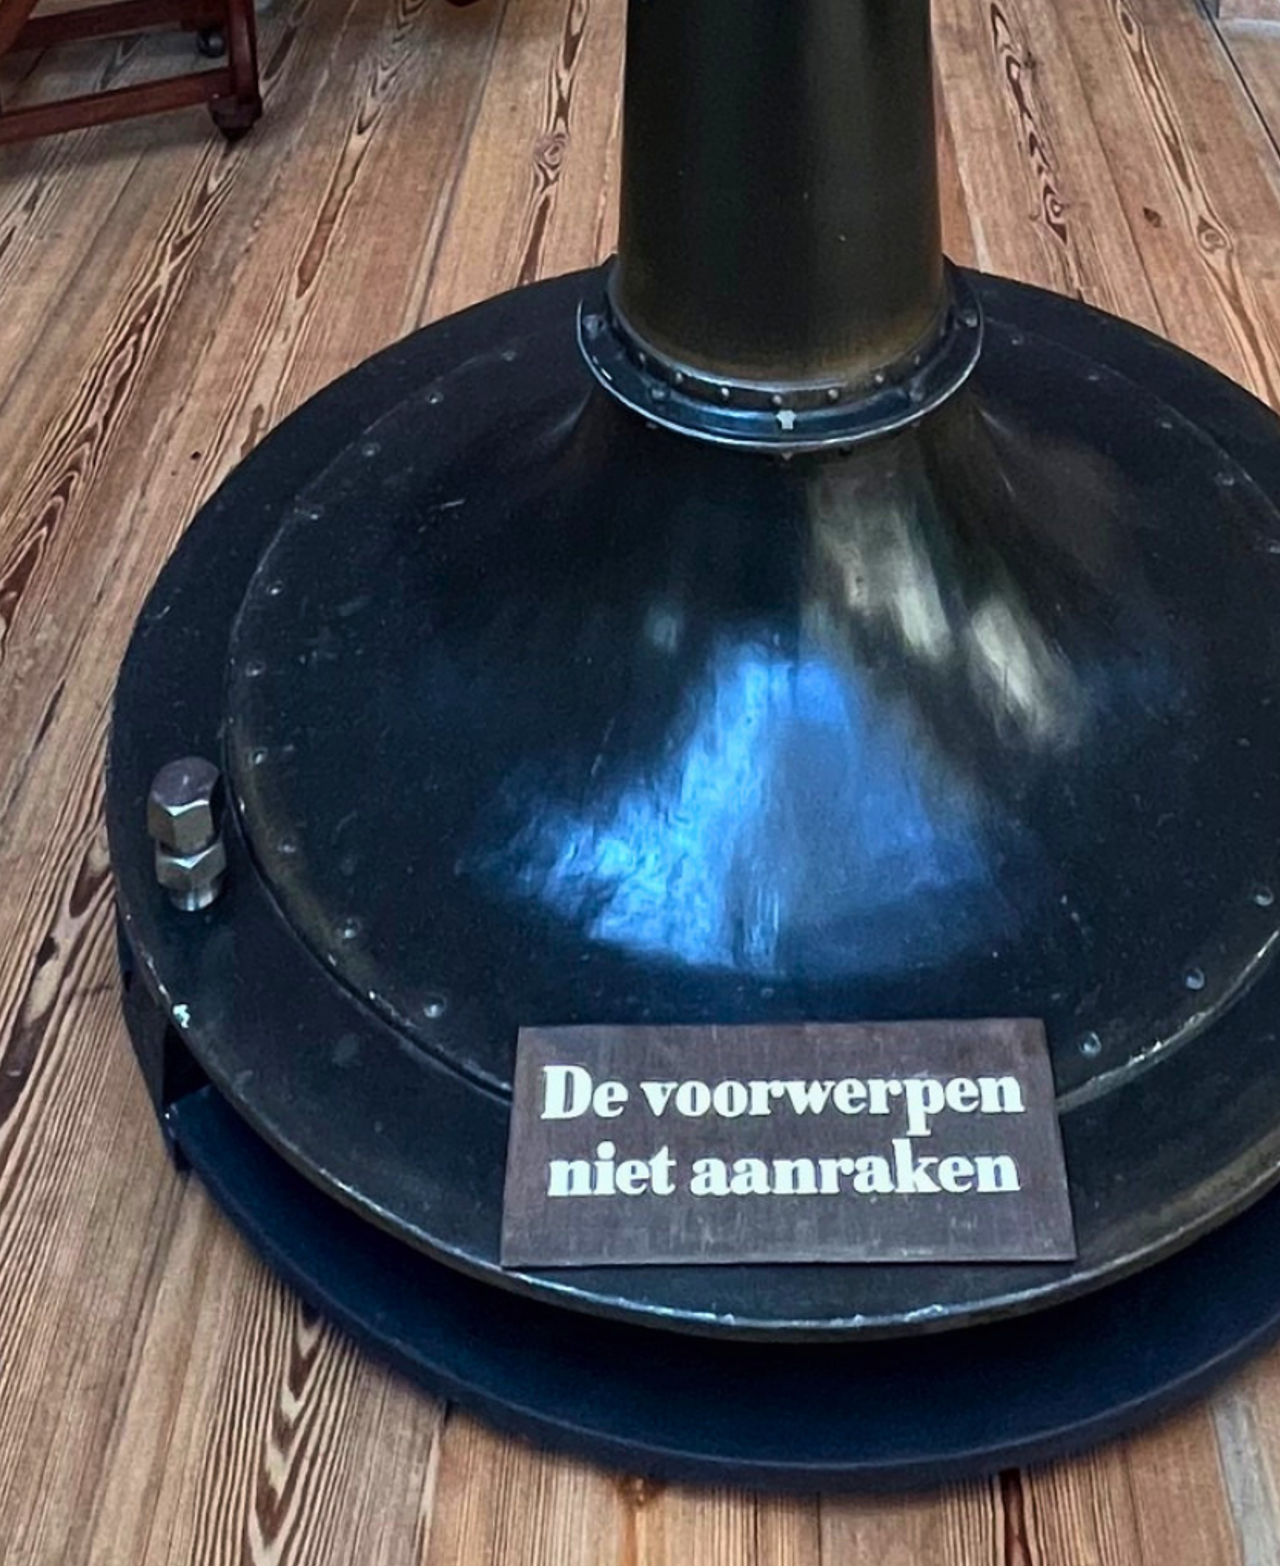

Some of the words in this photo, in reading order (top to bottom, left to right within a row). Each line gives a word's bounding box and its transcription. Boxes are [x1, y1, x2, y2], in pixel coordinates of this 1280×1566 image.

[540, 1064, 629, 1120] De
[639, 1075, 1026, 1137] voorwerpen
[547, 1140, 677, 1197] niet
[690, 1137, 1021, 1196] aanraken
